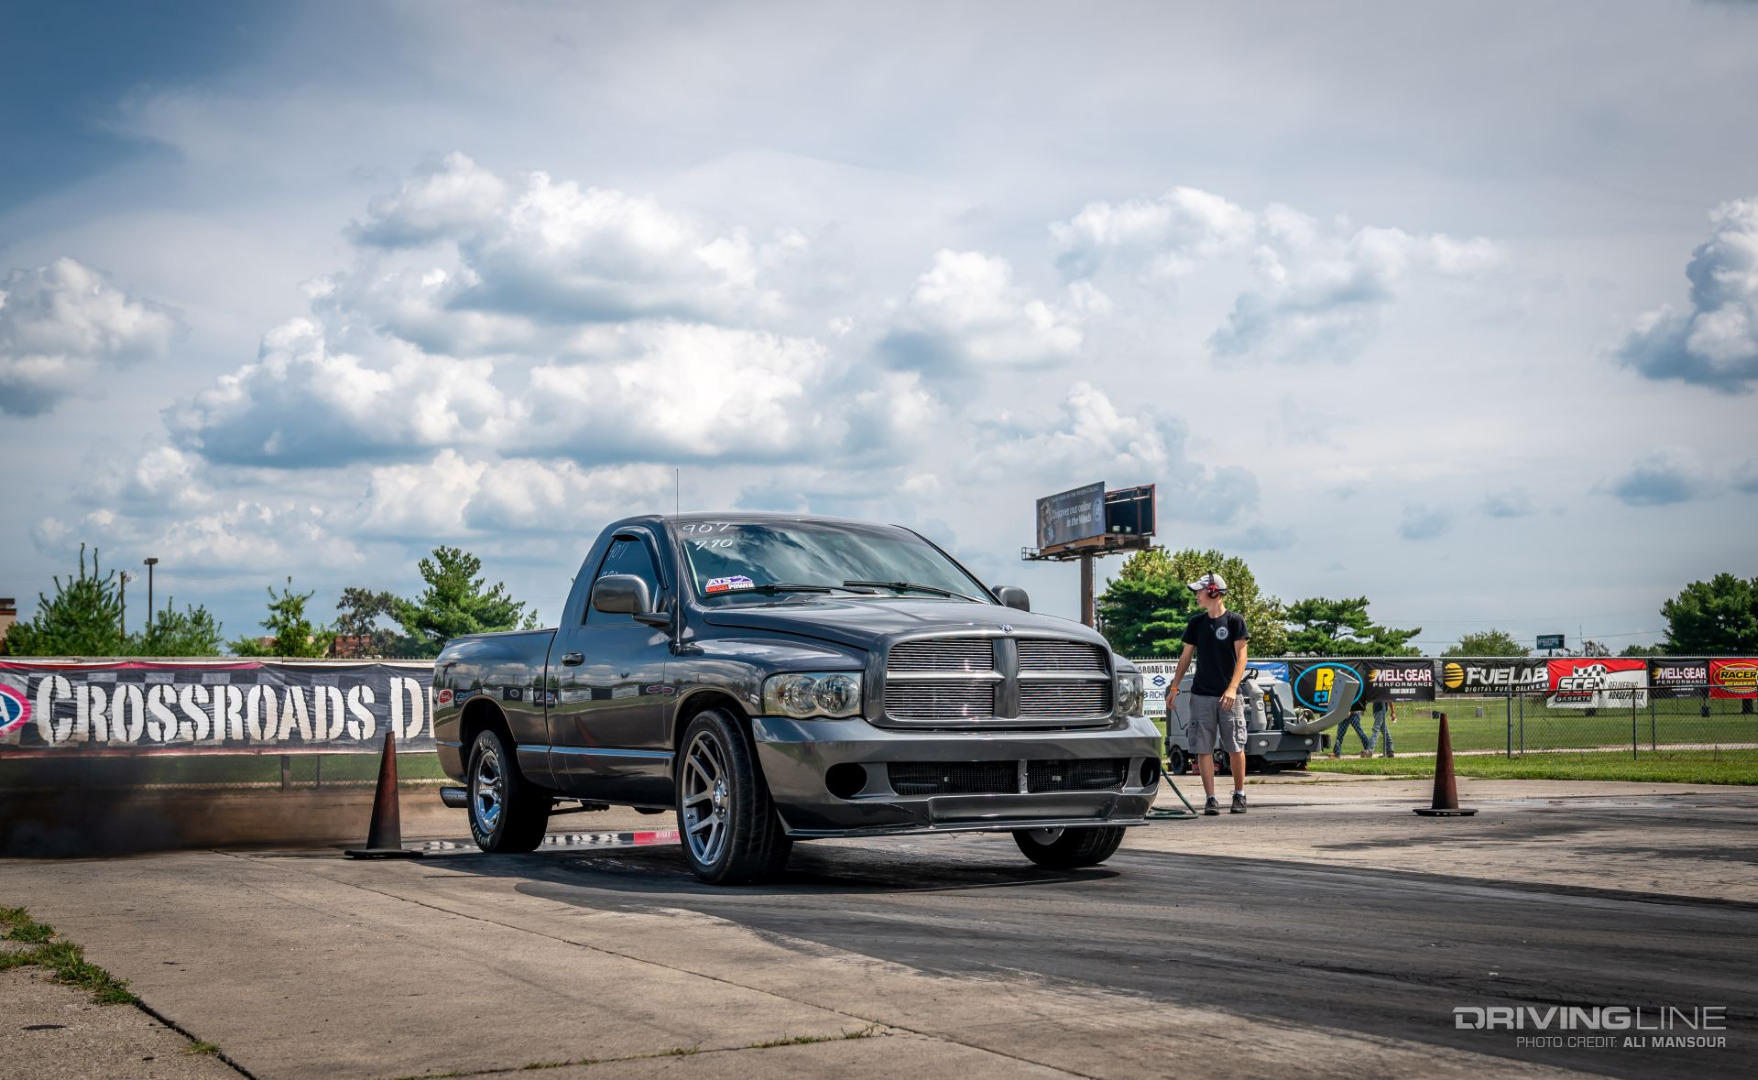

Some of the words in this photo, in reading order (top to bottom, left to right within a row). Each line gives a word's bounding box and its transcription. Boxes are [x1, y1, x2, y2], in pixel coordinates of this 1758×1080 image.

[682, 522, 730, 536] 907
[1374, 669, 1432, 682] MELL-GEAR
[1466, 667, 1549, 685] FUELAB
[1659, 667, 1707, 680] MELL-GEAR
[1560, 678, 1595, 693] SCE
[37, 675, 376, 743] CROSSROADS
